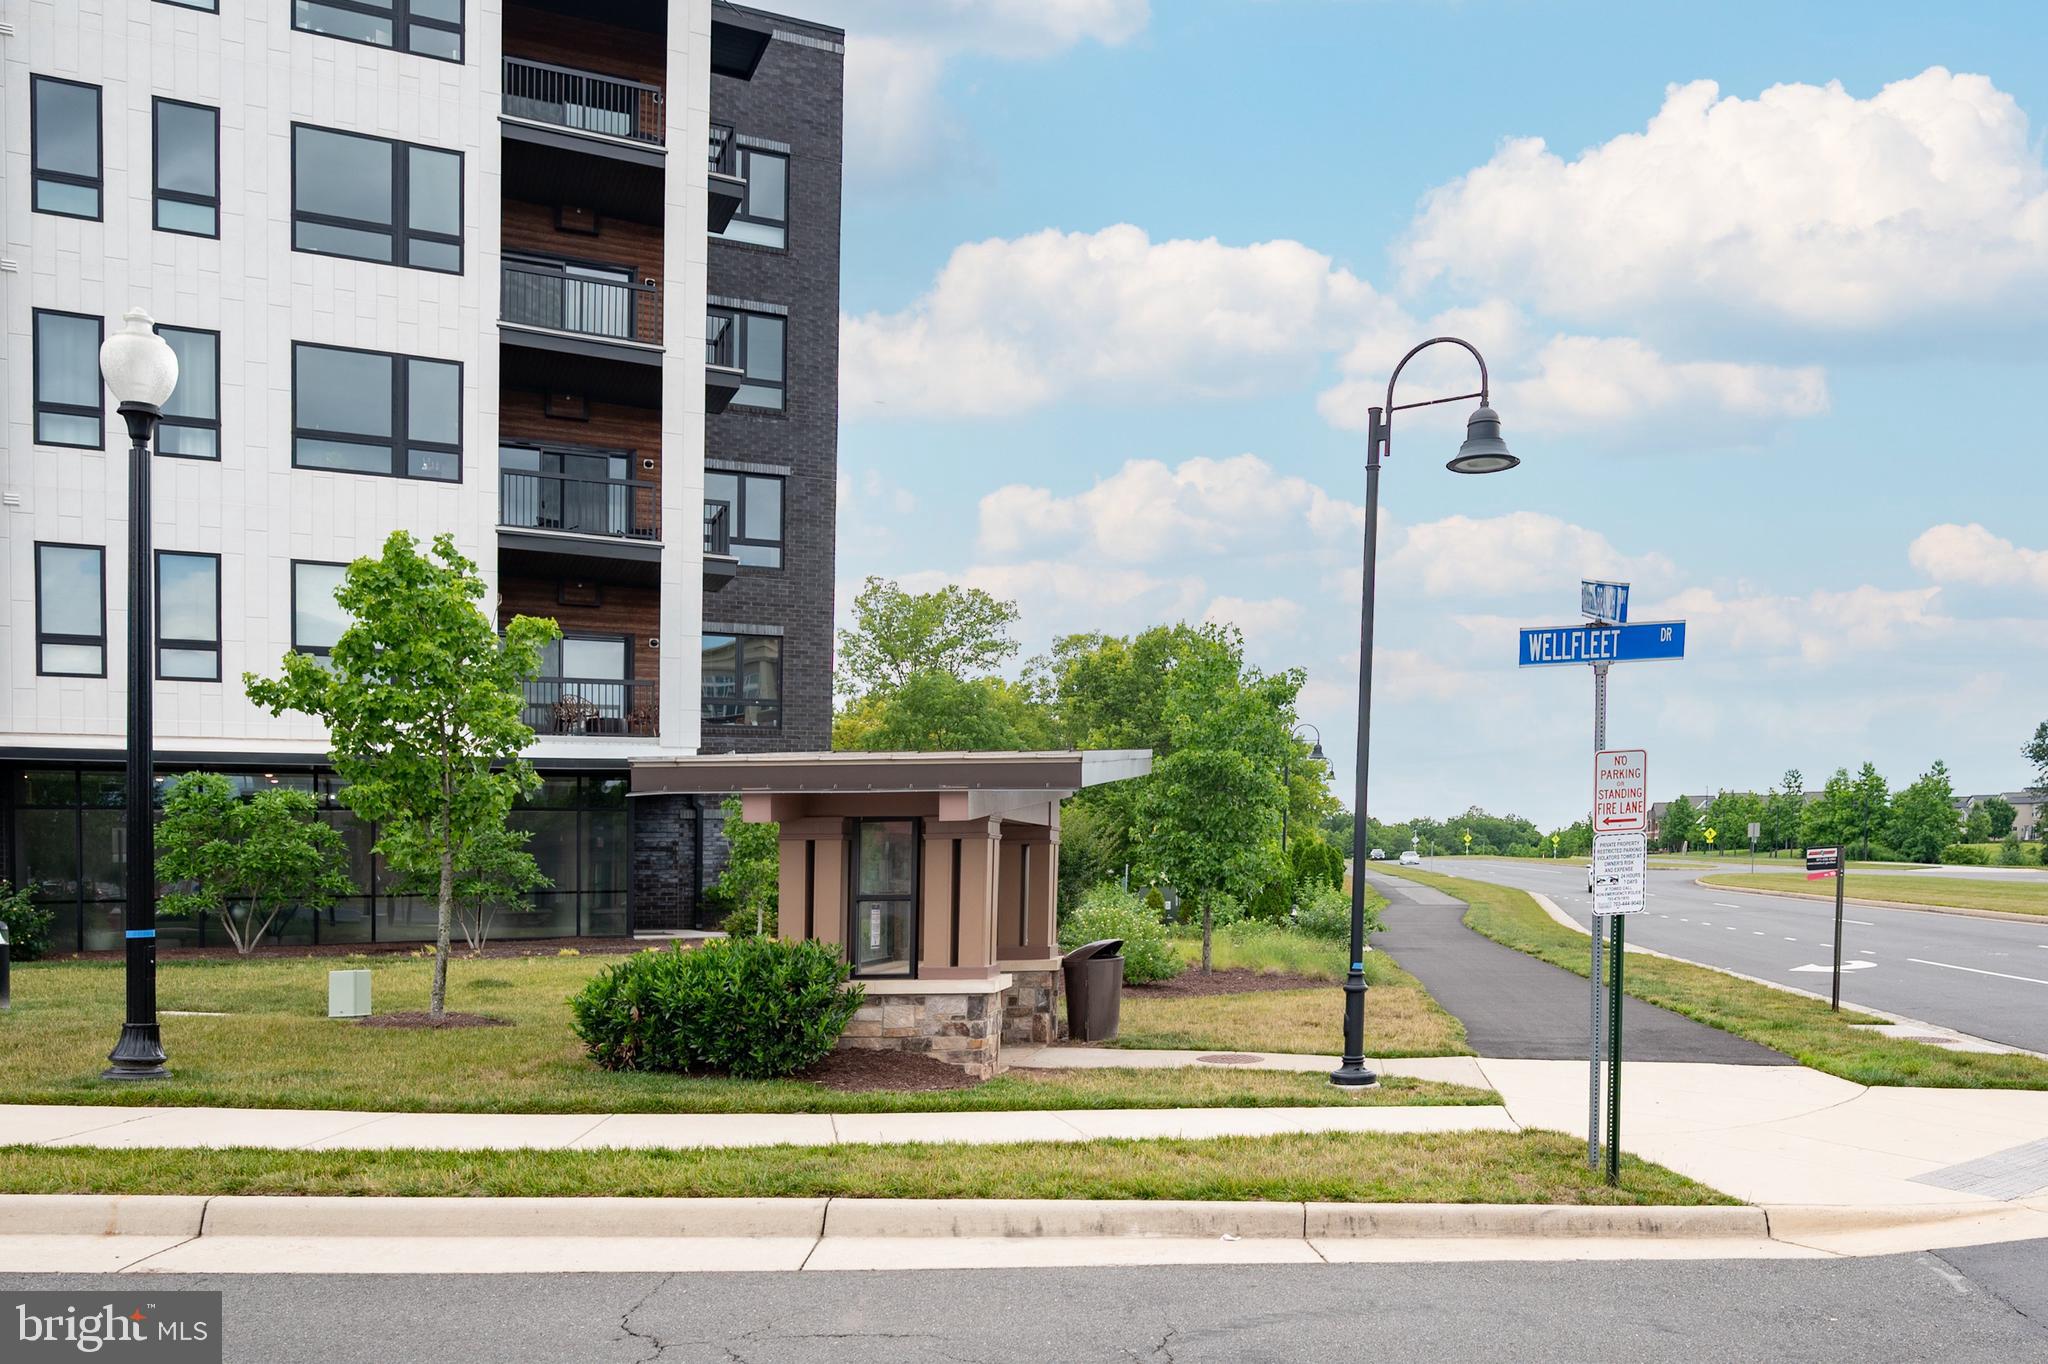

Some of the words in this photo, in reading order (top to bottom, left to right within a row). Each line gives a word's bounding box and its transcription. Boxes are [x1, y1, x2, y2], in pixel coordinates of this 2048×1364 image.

[1529, 629, 1620, 662] WELLFLEET
[1660, 627, 1672, 642] DR
[1614, 755, 1628, 766] NO
[1600, 768, 1641, 780] PARKING
[1598, 787, 1642, 800] STANDING
[1597, 802, 1617, 815] FIRE
[1620, 801, 1643, 815] LANE
